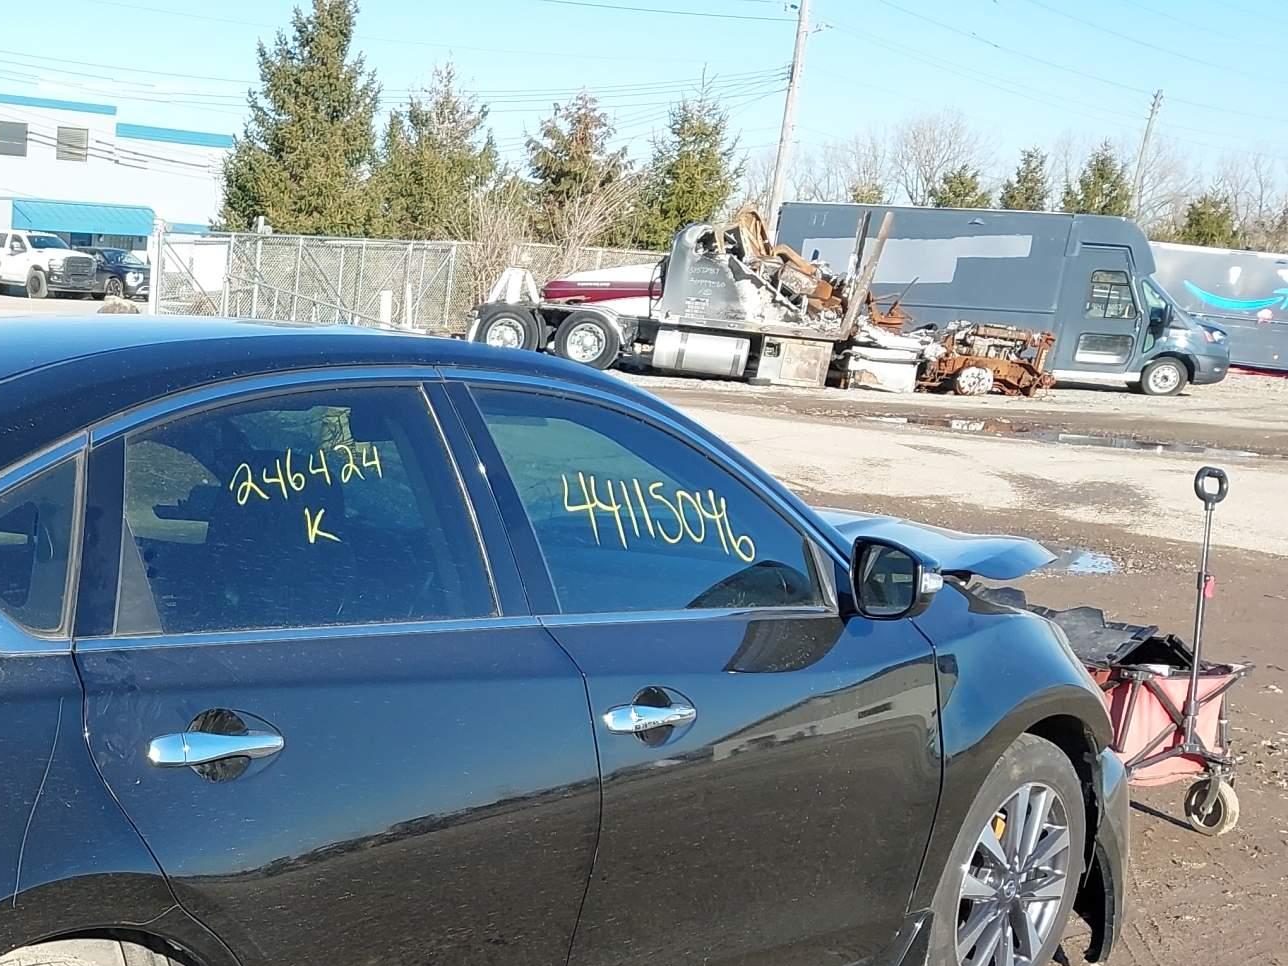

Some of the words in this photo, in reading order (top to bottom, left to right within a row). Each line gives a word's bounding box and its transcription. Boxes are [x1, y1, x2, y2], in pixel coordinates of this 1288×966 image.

[229, 444, 383, 506] 246424
[304, 506, 343, 544] K
[561, 471, 757, 562] 44115046
